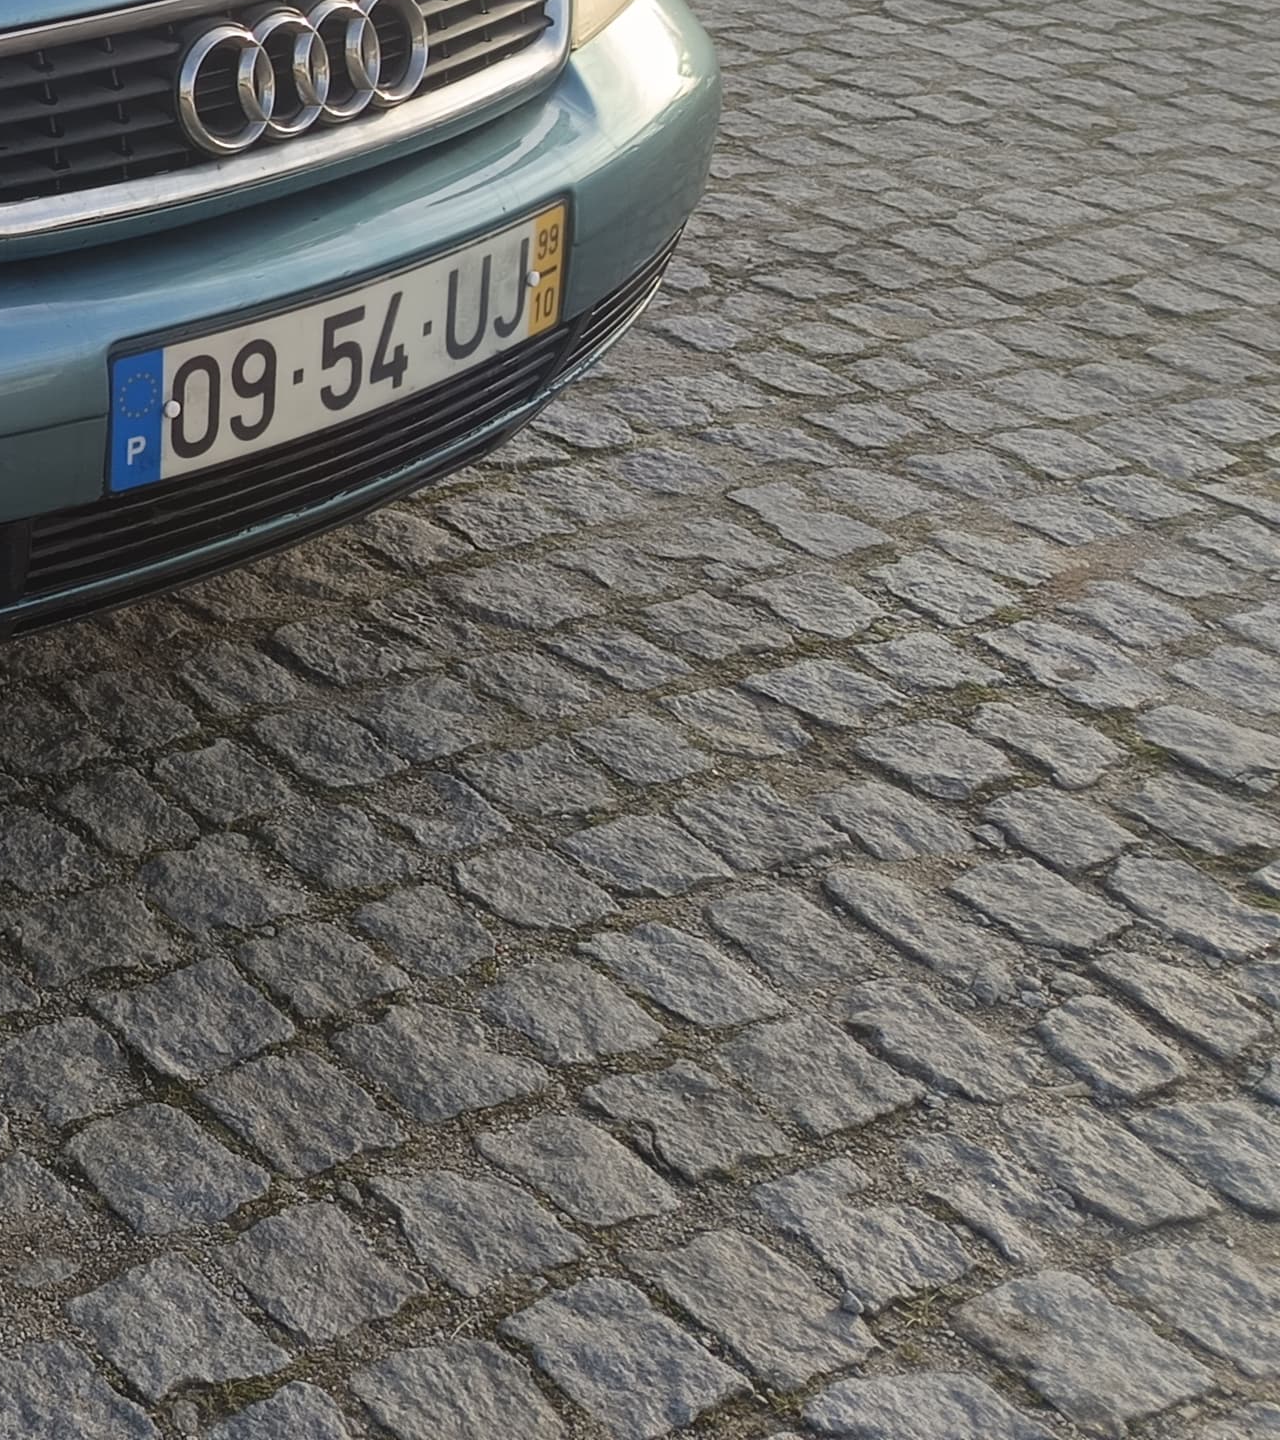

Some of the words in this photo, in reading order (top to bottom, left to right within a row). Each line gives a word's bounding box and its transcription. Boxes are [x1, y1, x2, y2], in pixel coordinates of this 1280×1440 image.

[538, 223, 559, 261] 99
[535, 287, 554, 323] 10
[127, 436, 147, 466] P
